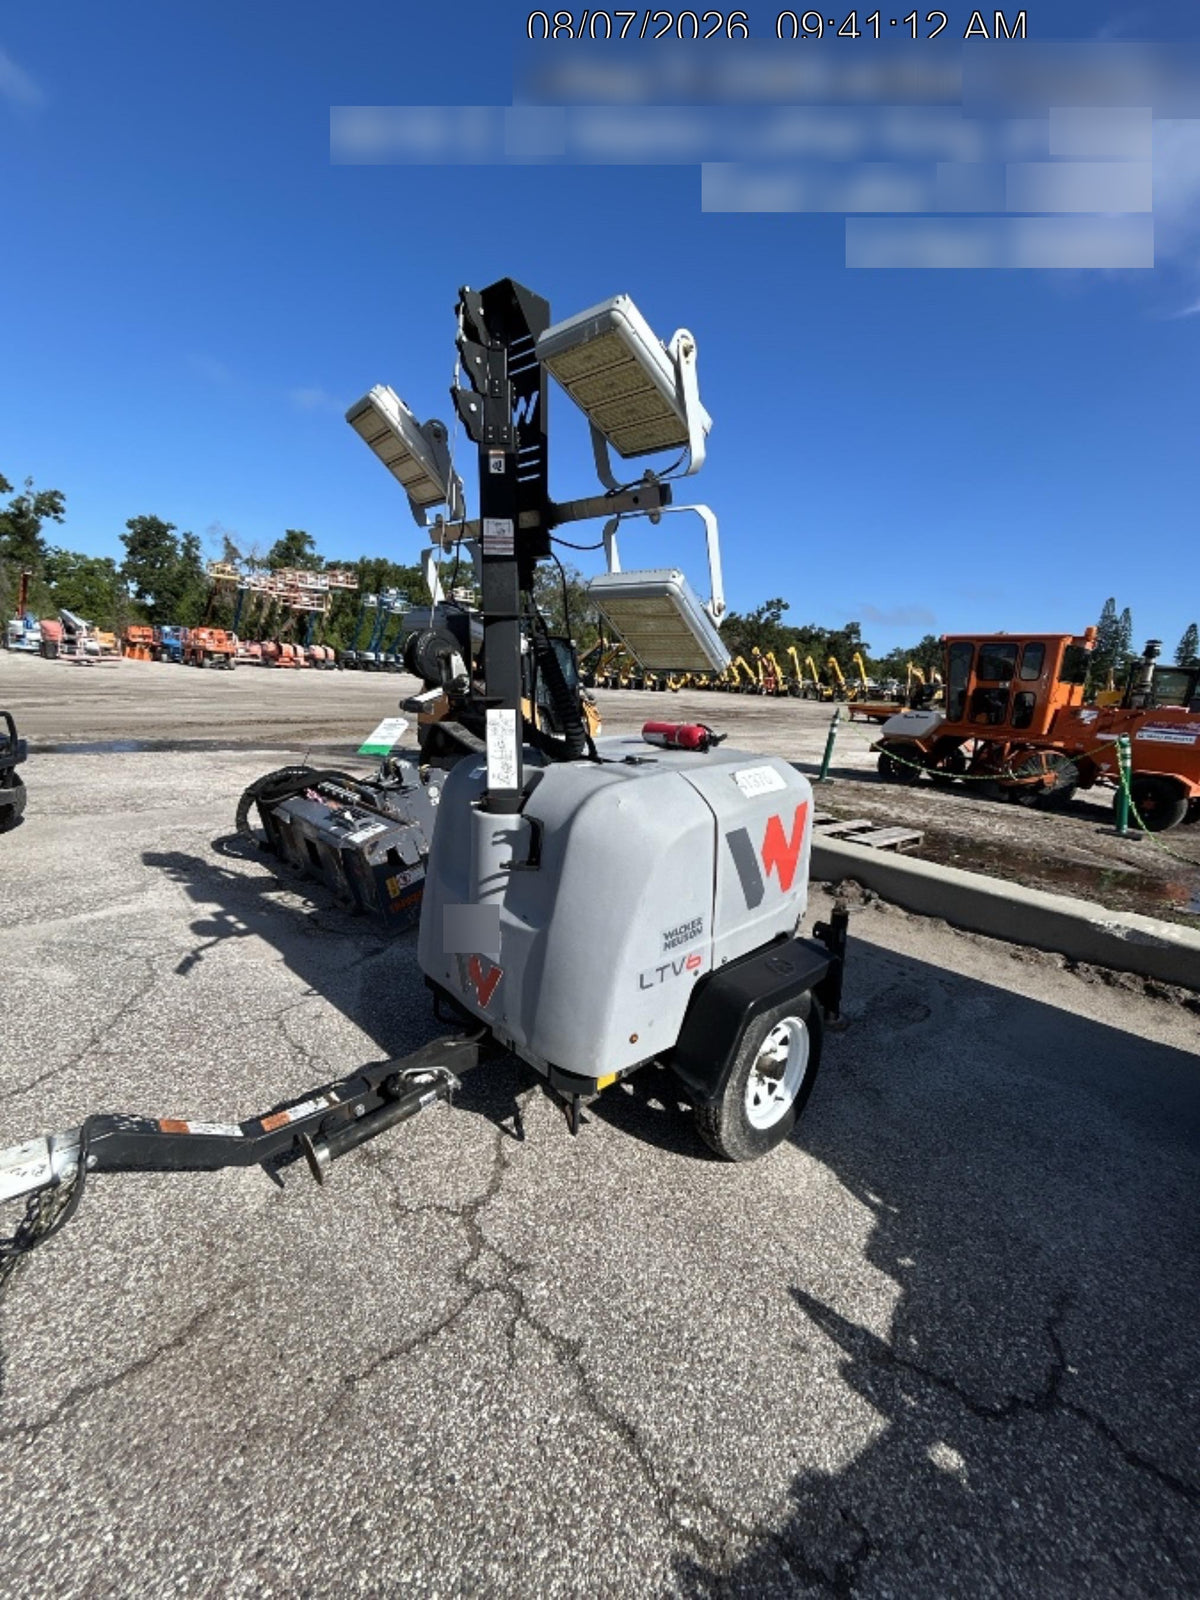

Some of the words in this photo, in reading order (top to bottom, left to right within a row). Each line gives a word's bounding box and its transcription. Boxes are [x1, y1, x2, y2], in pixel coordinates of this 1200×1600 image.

[663, 917, 704, 941] WACKER
[663, 926, 704, 952] NEUSON
[639, 953, 702, 990] LTV6
